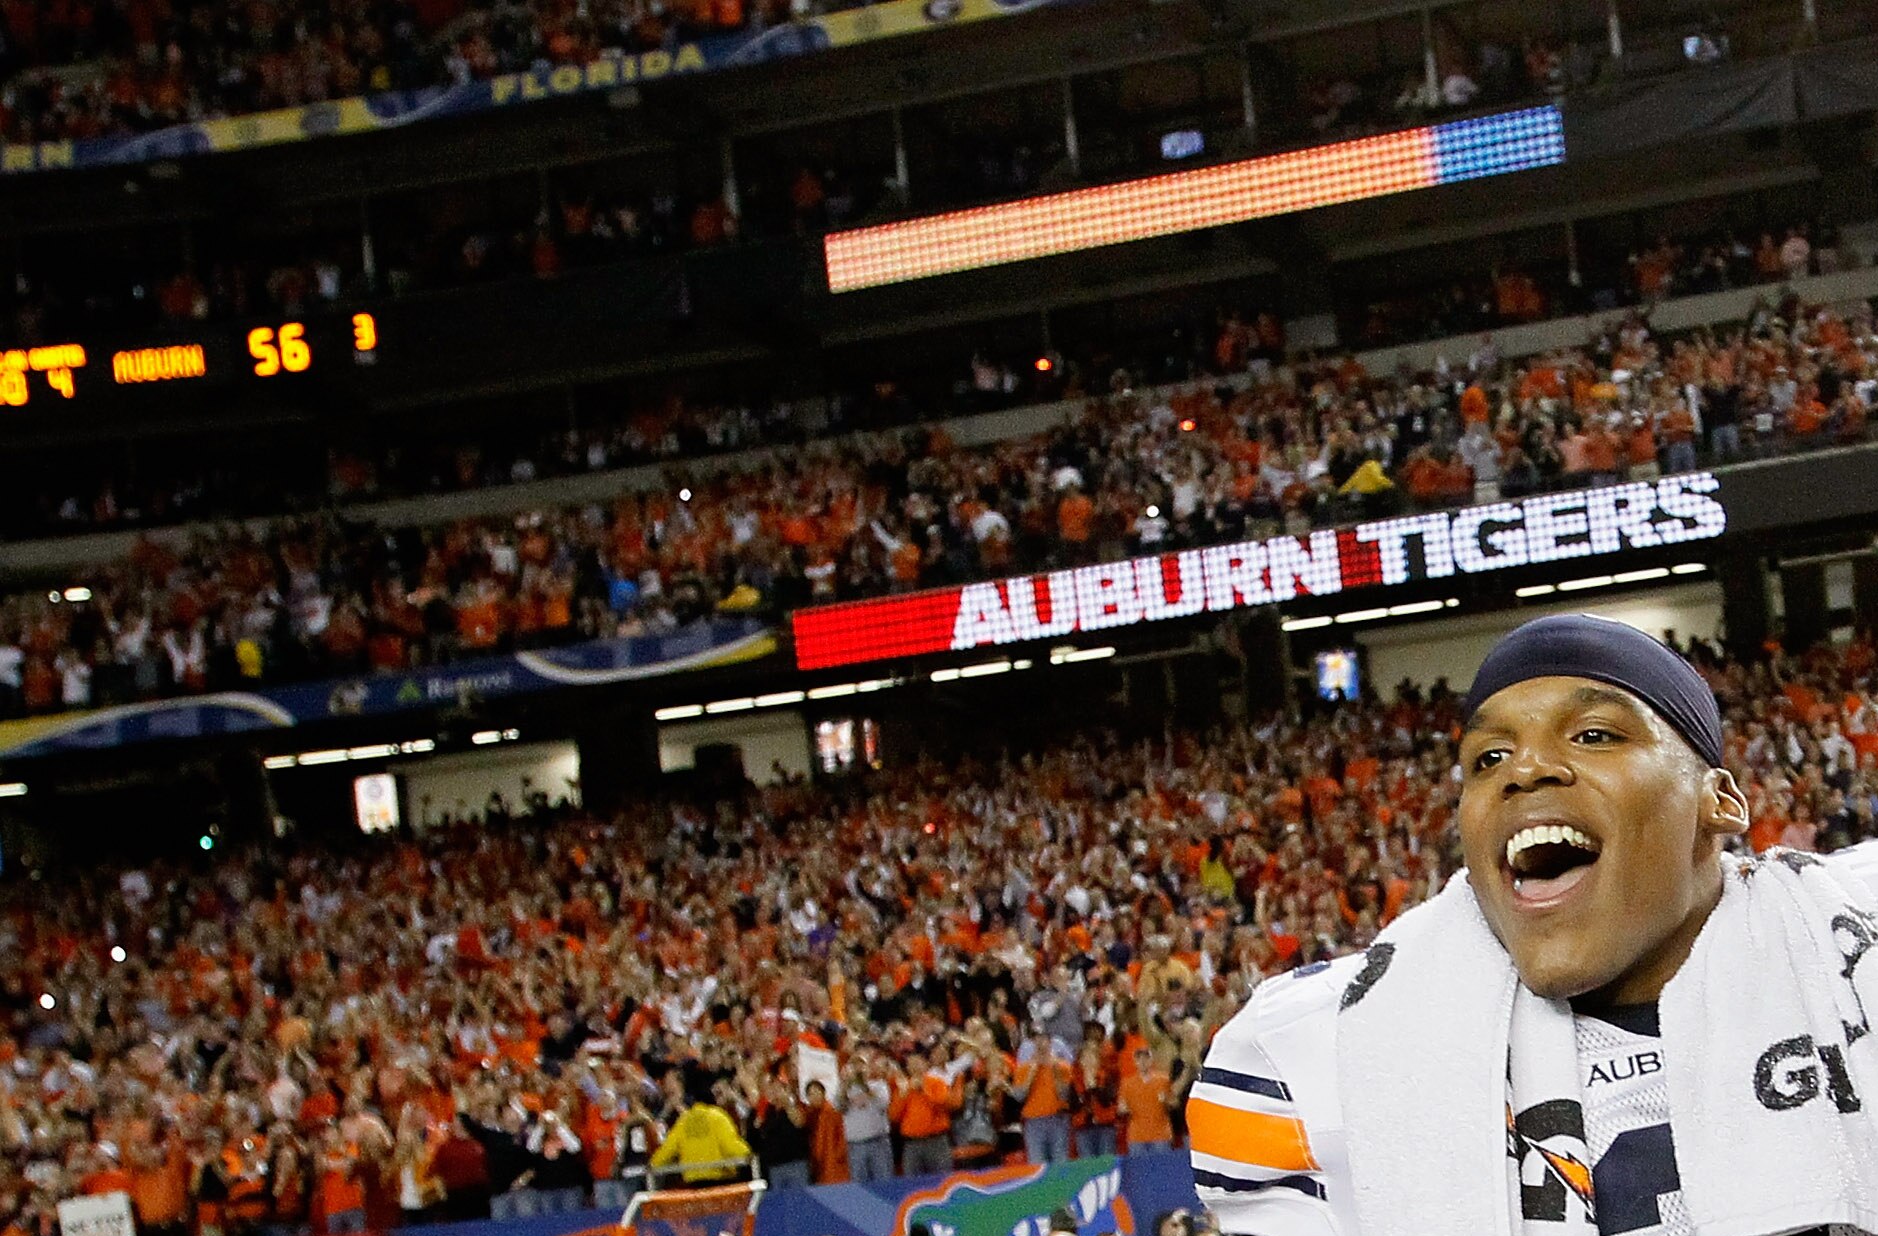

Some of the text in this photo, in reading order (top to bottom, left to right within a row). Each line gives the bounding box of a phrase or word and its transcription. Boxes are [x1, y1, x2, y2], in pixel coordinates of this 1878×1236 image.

[490, 44, 706, 102] FLORIDA
[248, 322, 311, 377] 56
[951, 472, 1727, 651] AUBURN TIGERS
